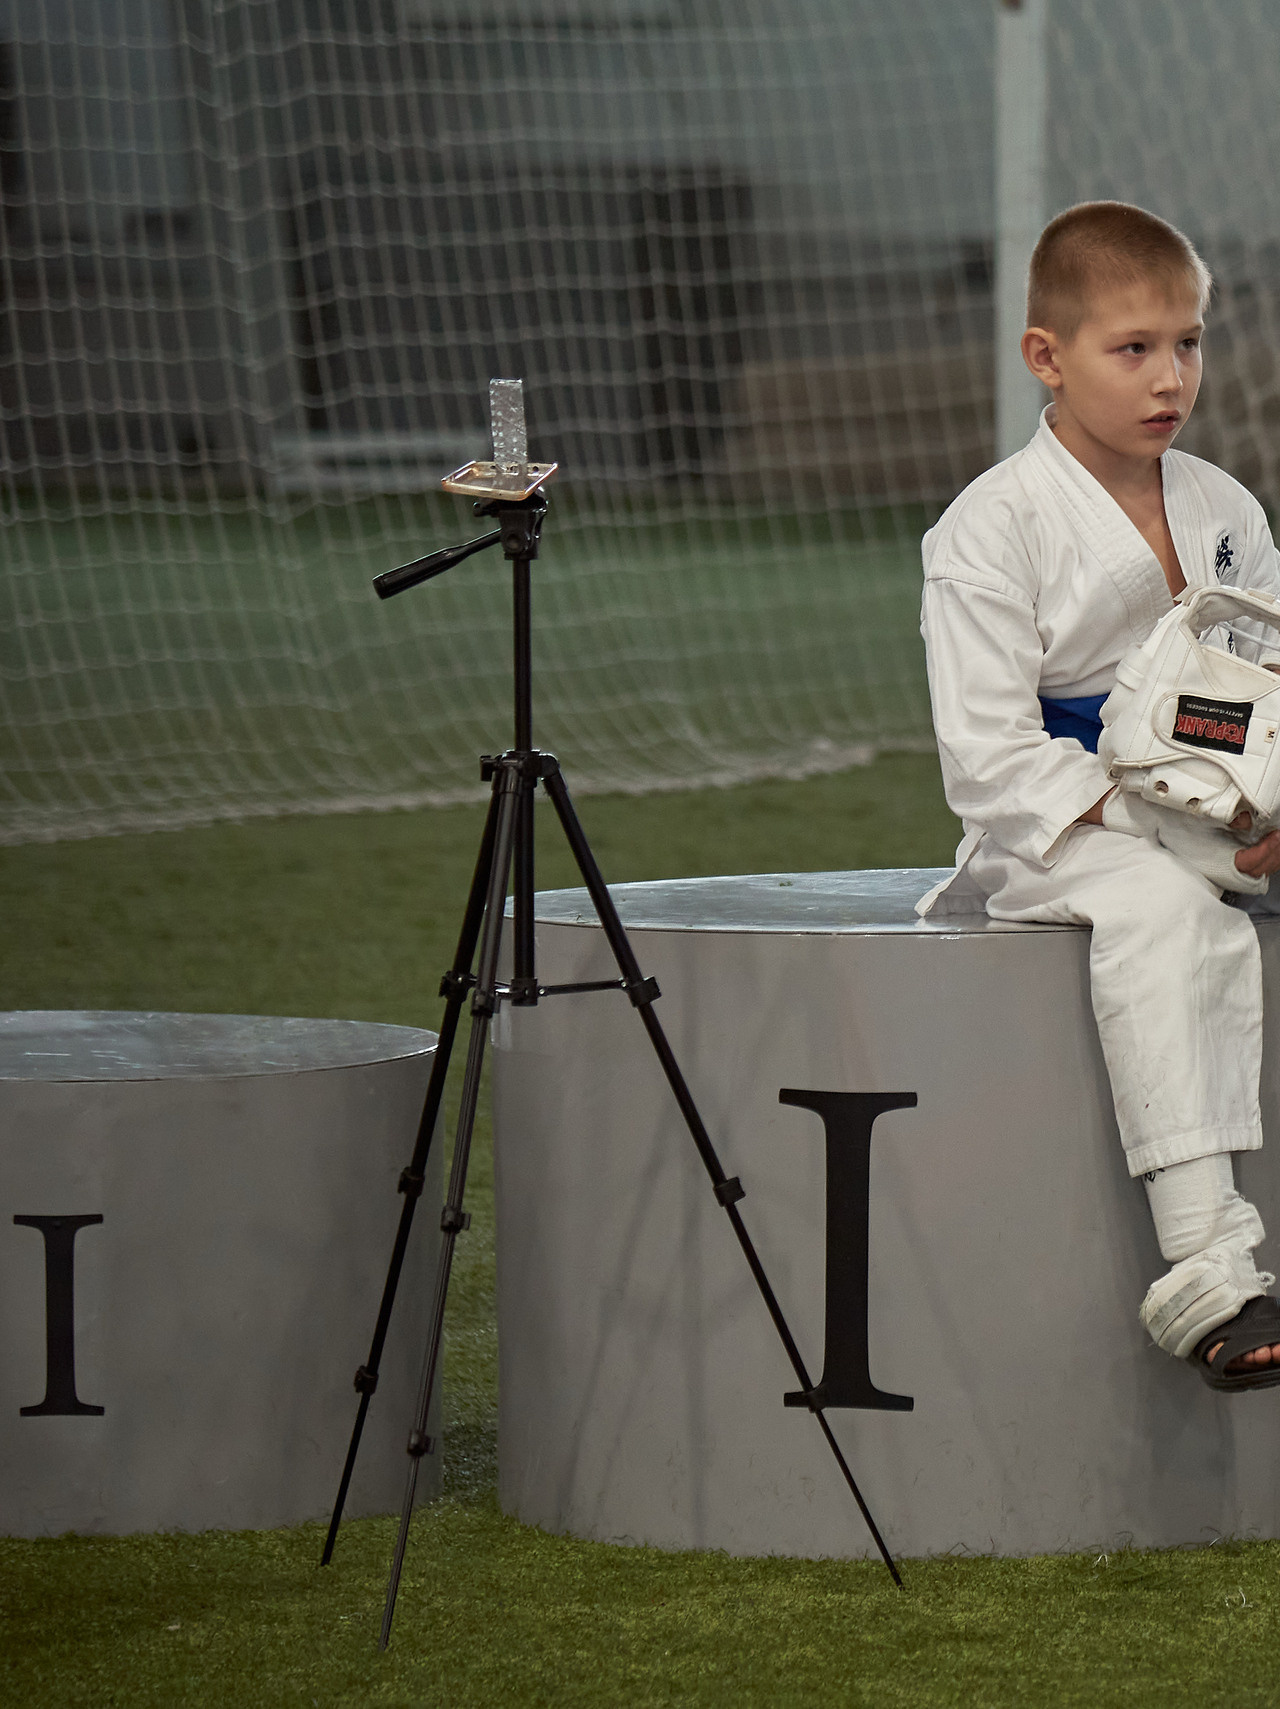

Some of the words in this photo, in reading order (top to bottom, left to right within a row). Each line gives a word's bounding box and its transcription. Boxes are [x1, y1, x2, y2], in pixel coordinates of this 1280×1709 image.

[1186, 703, 1208, 712] SUCCESS
[1225, 710, 1244, 718] SAFETY
[1175, 713, 1246, 744] TOPRANK
[1267, 730, 1275, 739] M
[779, 1088, 918, 1412] I
